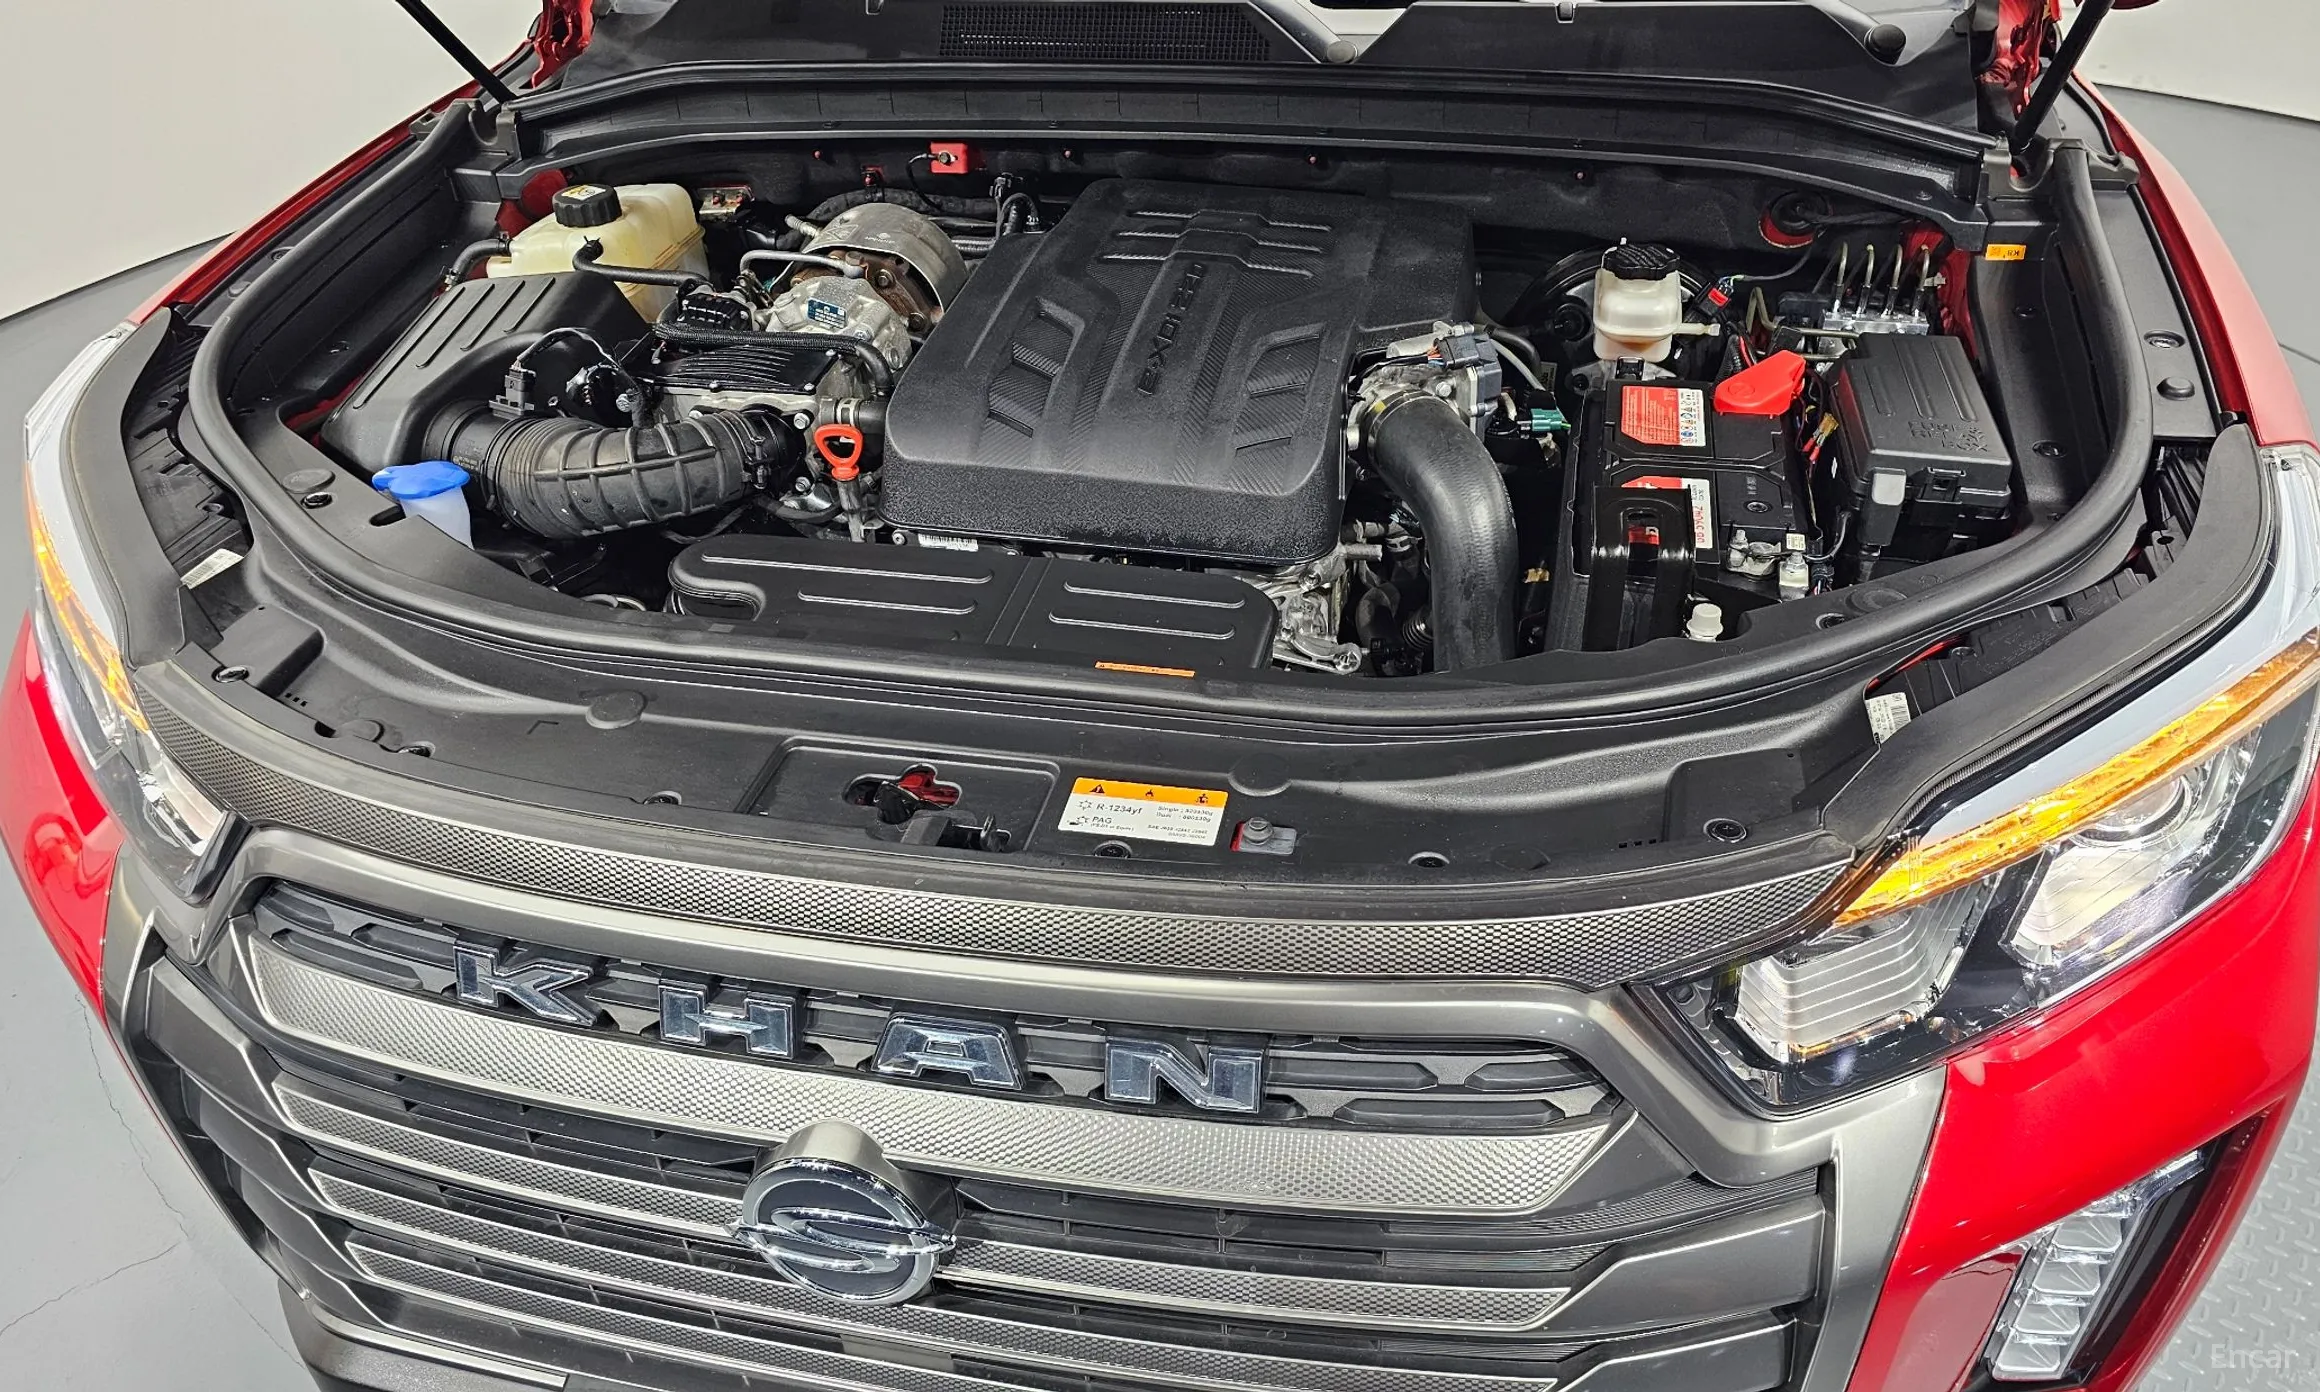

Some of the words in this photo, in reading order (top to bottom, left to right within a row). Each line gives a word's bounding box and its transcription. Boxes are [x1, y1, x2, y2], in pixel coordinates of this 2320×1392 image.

[1095, 803, 1143, 816] R-1234yf
[1091, 816, 1113, 825] PAG
[453, 940, 1264, 1113] KHAN
